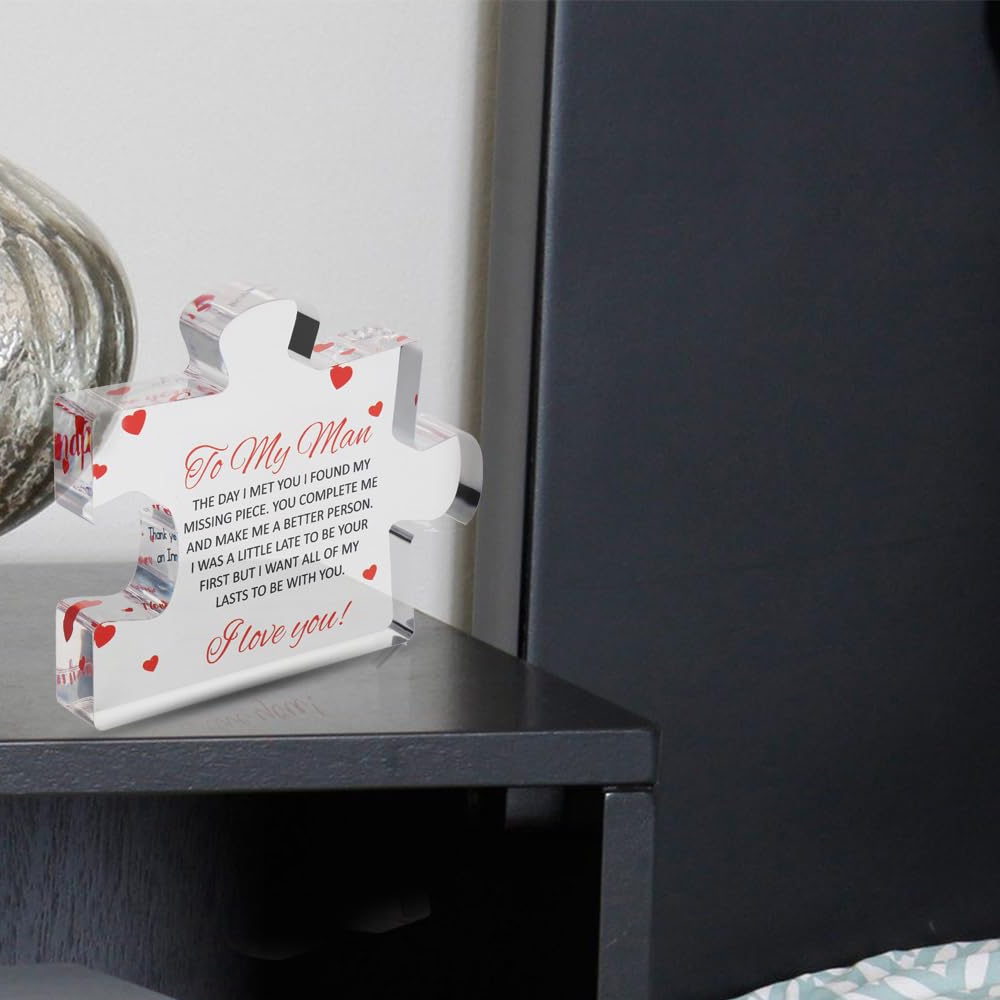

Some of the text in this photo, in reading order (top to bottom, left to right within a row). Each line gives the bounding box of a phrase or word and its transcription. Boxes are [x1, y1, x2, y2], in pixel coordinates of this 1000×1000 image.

[185, 417, 373, 489] To My Man
[184, 477, 378, 534] MISSING PIECE. YOU COMPLETE ME
[193, 459, 371, 511] THE DAY I MET YOU I FOUND MY
[186, 499, 373, 554] AND MAKE ME A BETTER PERSON.
[191, 519, 368, 574] I WAS A LITTLE LATE TO BE YOUR
[200, 541, 359, 592] FIRST BUT I WANT ALL OF MY
[216, 565, 344, 608] LASTS TO BE WITH YOU.
[207, 600, 352, 664] I love you!
